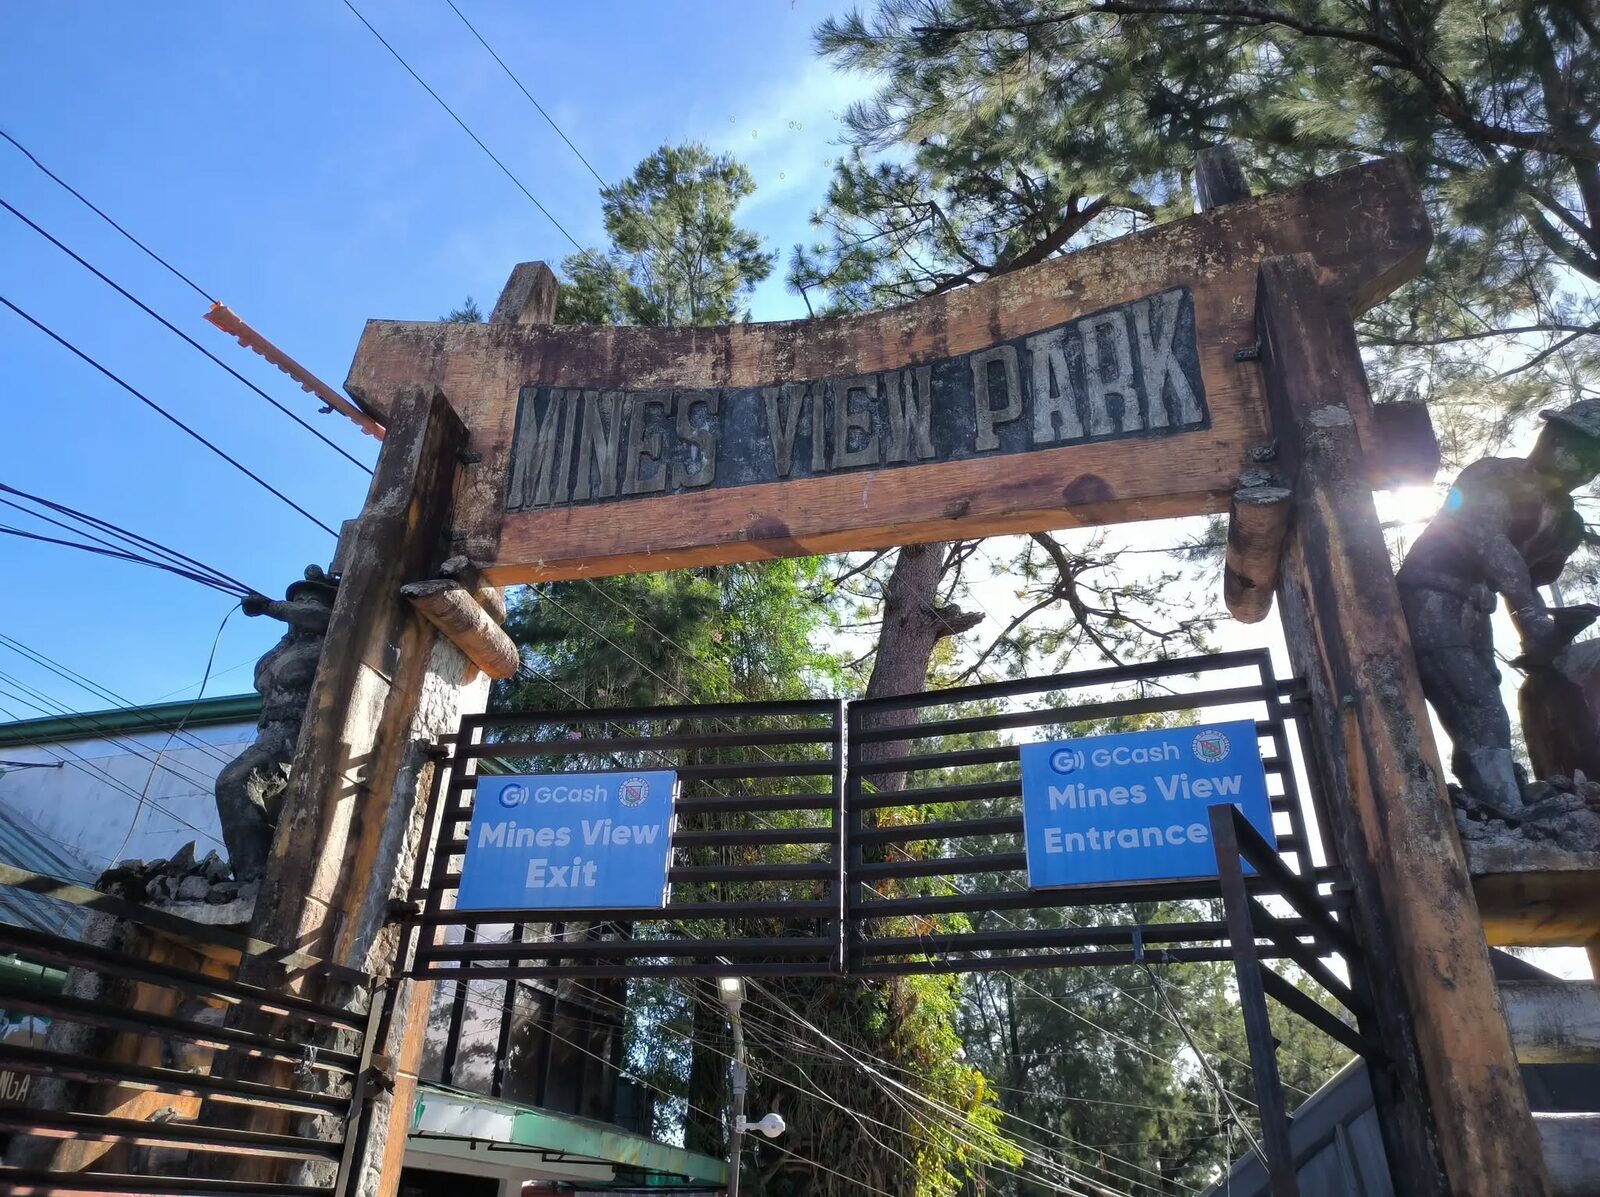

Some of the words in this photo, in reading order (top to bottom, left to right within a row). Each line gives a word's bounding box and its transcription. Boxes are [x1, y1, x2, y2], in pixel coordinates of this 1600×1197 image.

[507, 387, 721, 510] MINES
[761, 366, 936, 478] VIEW
[970, 288, 1203, 450] PARK
[1091, 741, 1180, 768] GCash
[534, 784, 608, 803] GCash
[1048, 783, 1147, 811] Mines
[1154, 773, 1242, 801] View
[477, 820, 571, 849] Mines
[580, 818, 661, 846] View
[1044, 822, 1209, 854] Entrance
[525, 856, 598, 889] Exit
